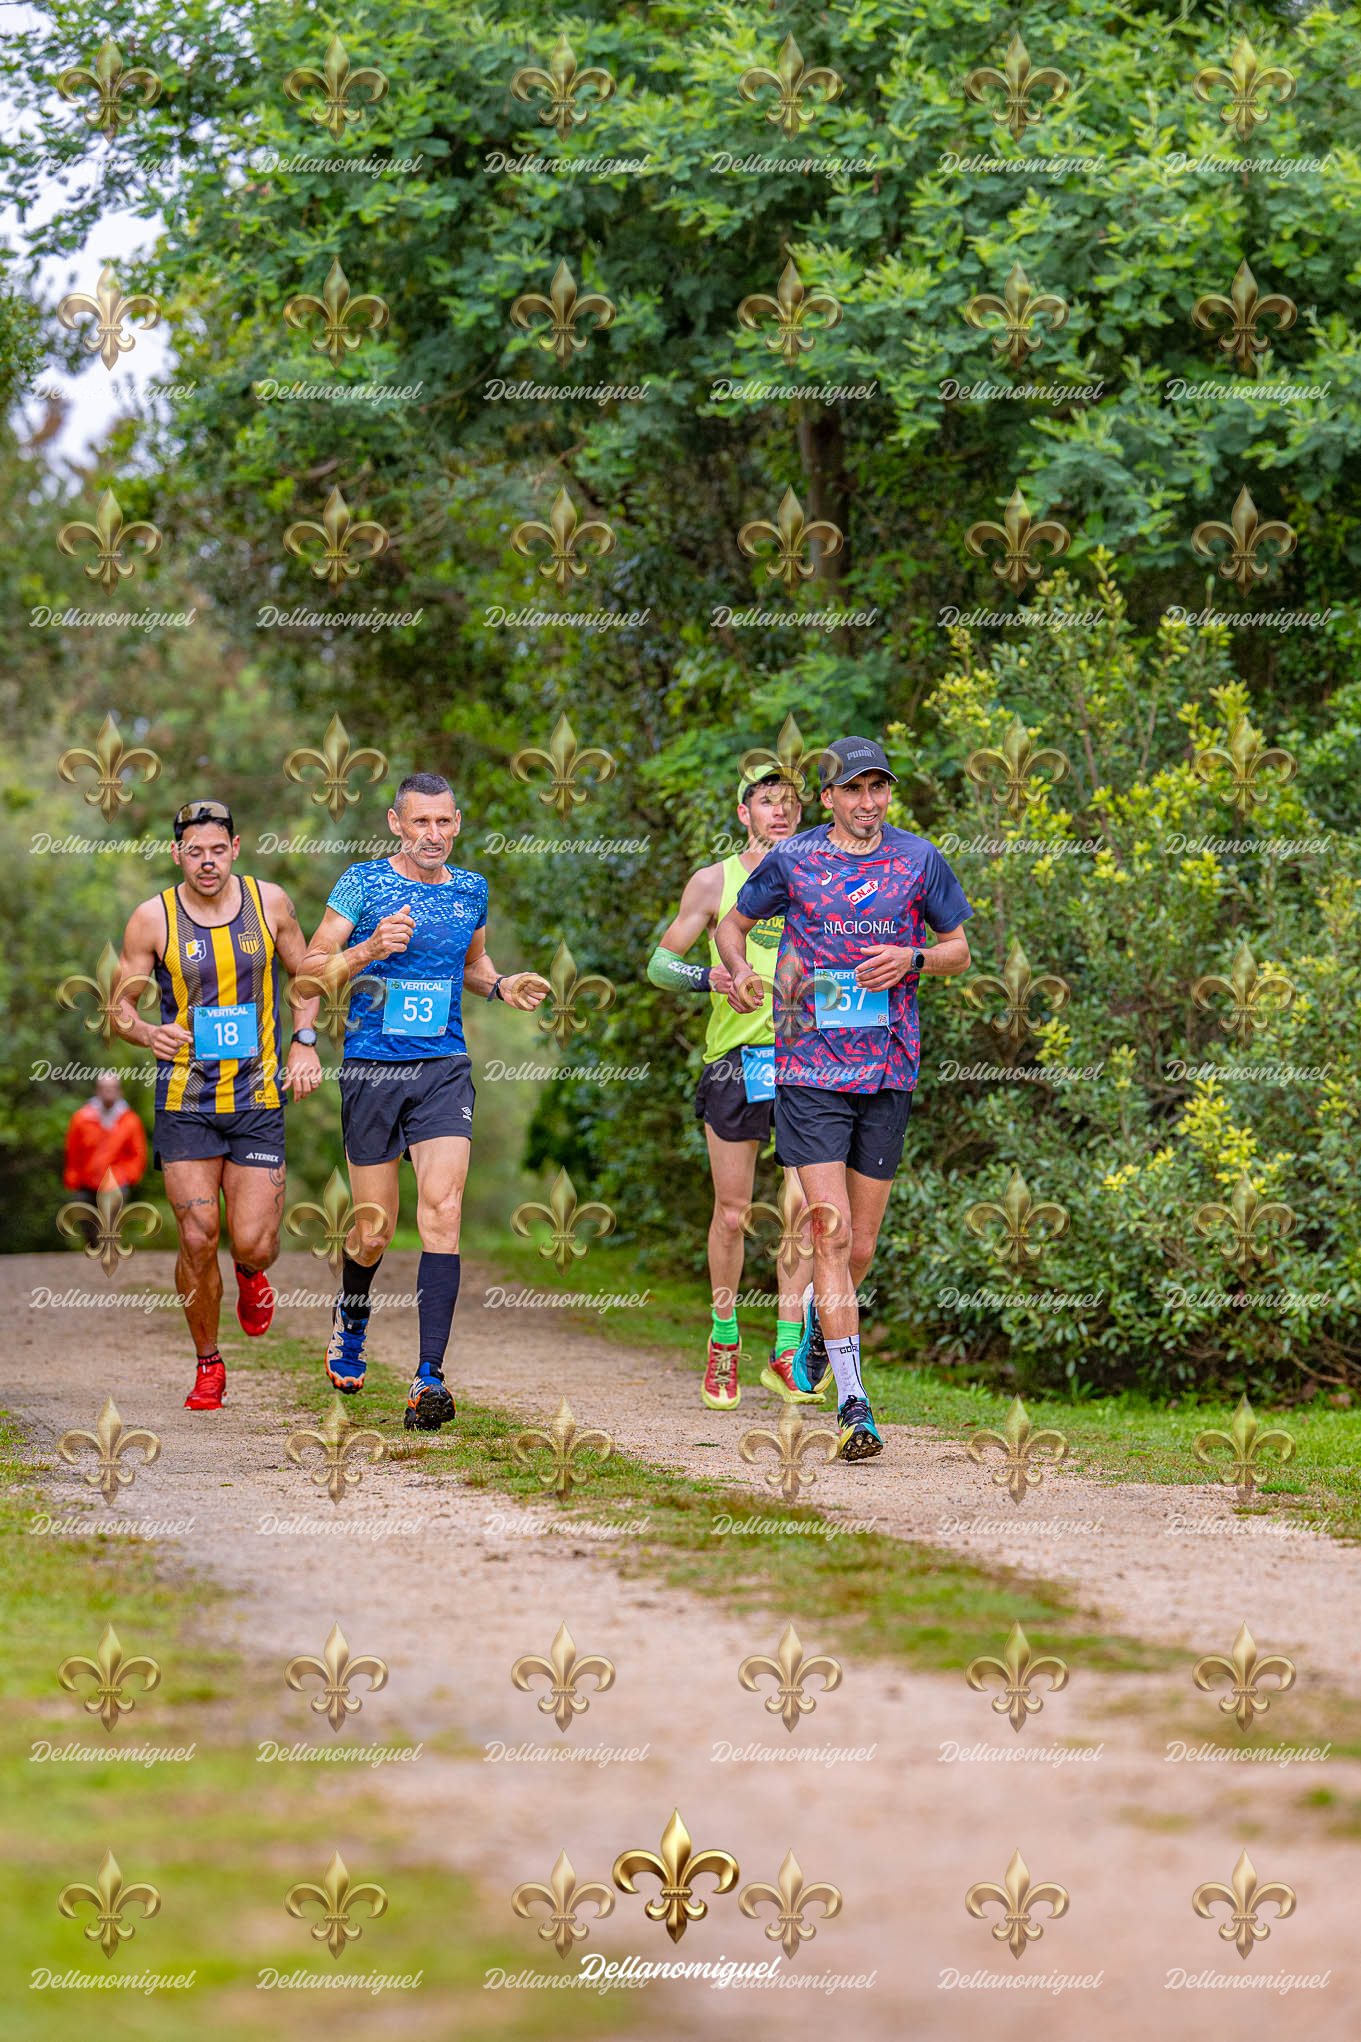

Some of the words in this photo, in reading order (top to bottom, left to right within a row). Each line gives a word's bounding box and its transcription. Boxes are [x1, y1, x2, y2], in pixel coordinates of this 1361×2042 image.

[823, 920, 897, 934] NACIONAL
[401, 982, 444, 991] VERTICAL
[836, 986, 868, 1011] 57
[207, 1006, 249, 1018] VERTICAL
[402, 996, 434, 1023] 53
[214, 1022, 239, 1047] 18
[755, 1050, 775, 1058] VER
